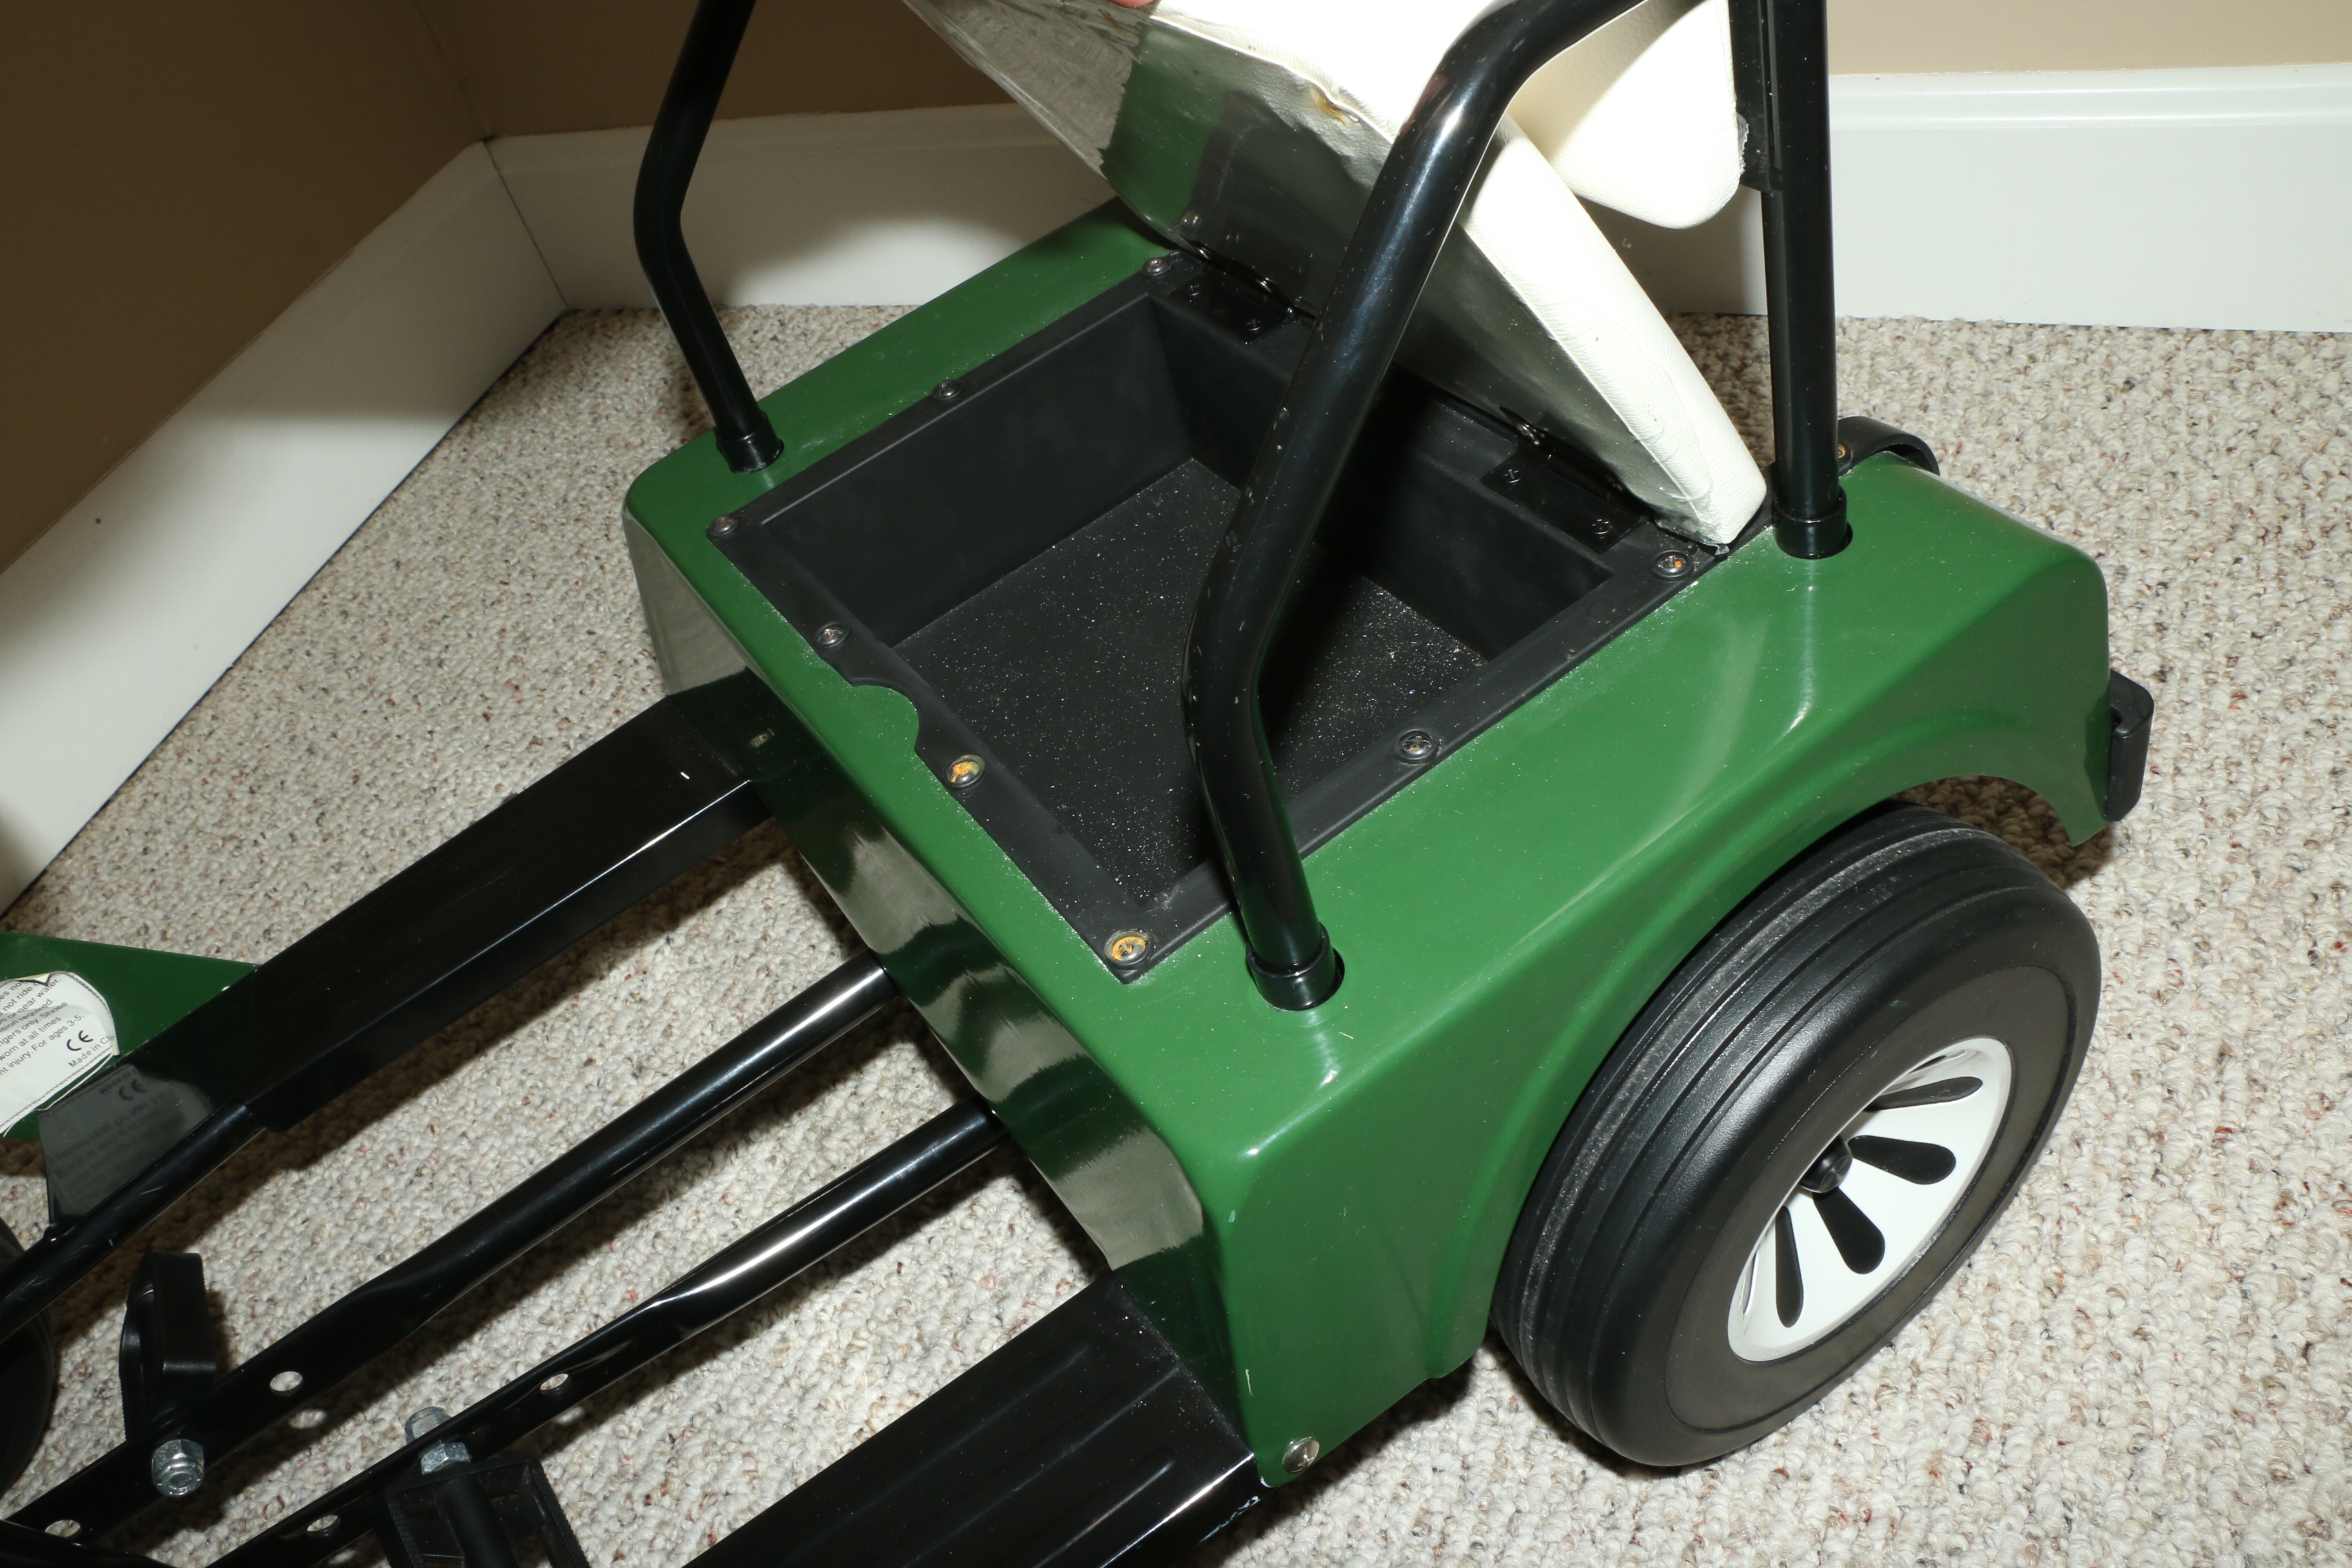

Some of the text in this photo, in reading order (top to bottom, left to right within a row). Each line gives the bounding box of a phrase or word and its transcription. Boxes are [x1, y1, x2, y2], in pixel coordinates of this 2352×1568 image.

[3, 999, 17, 1011] not
[17, 986, 33, 999] ride
[17, 997, 37, 1013] near
[40, 1001, 68, 1018] Shoes
[0, 999, 55, 1033] sion required.
[19, 1038, 29, 1046] at
[28, 1030, 39, 1040] all
[38, 1017, 61, 1032] times
[31, 1039, 47, 1051] For
[48, 1025, 68, 1041] ages
[66, 1014, 84, 1026] 3-5.
[68, 1050, 92, 1068] Made
